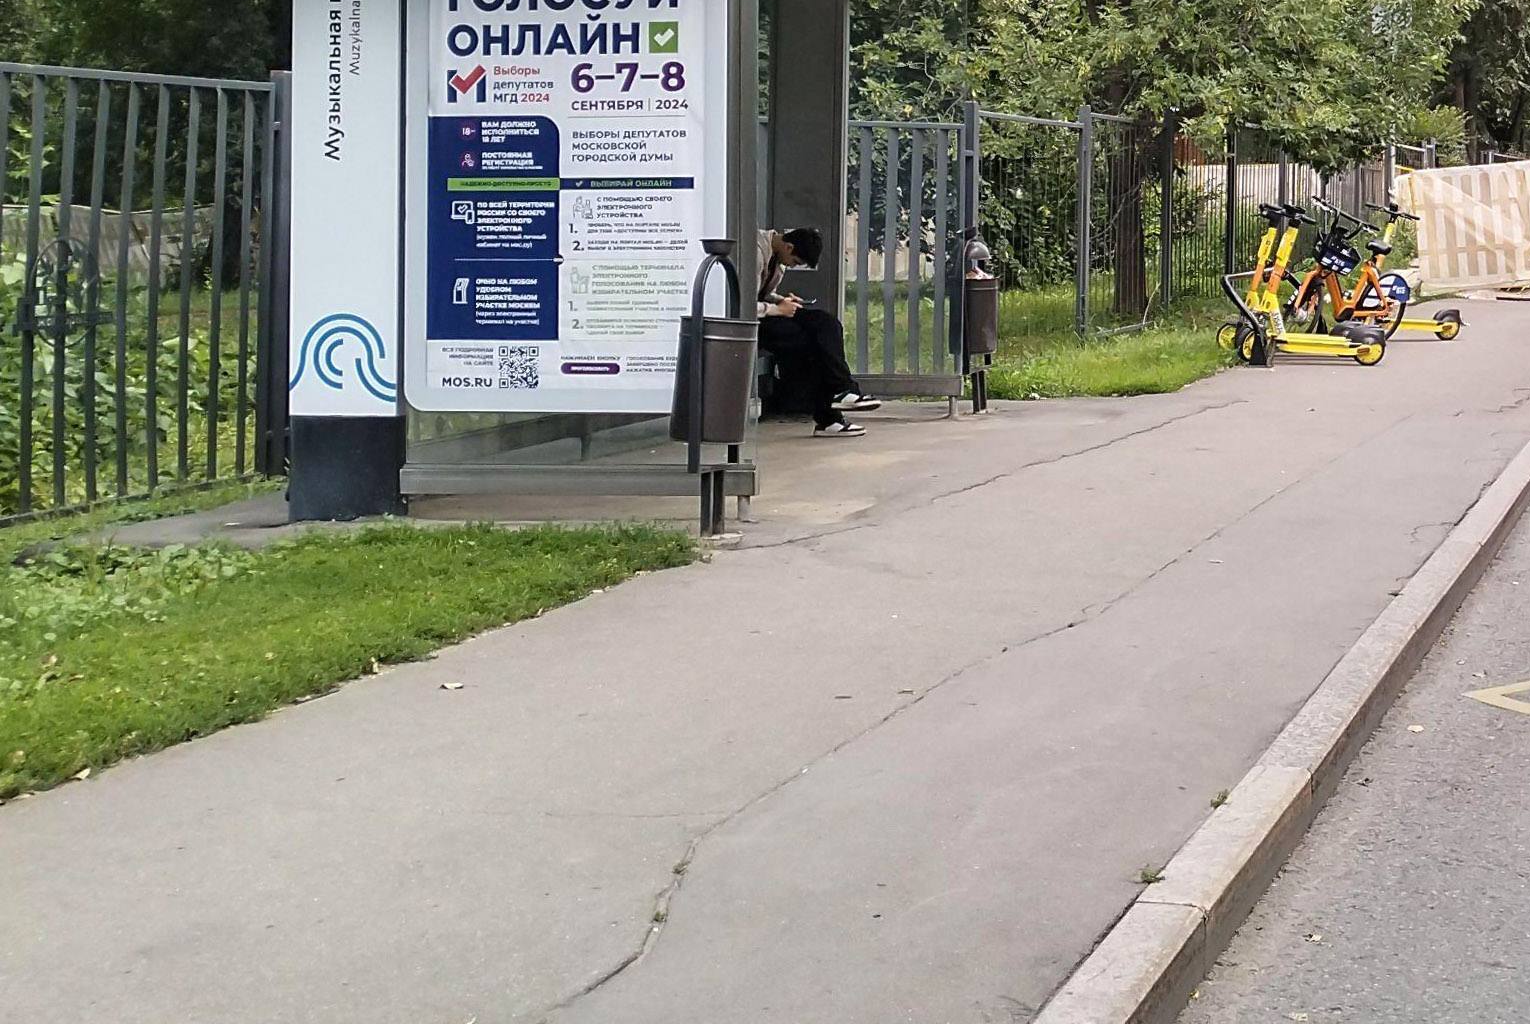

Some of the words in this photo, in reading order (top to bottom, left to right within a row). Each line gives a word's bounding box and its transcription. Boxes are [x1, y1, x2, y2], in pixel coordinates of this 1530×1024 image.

[447, 13, 640, 57] ОНЛАЙН
[493, 65, 540, 75] Выборы
[324, 10, 344, 161] Музыкальная
[493, 79, 554, 90] депутатов
[493, 93, 519, 104] МГД
[520, 93, 550, 103] 2024
[571, 100, 644, 111] СЕНТЯБРЯ
[655, 98, 689, 110] 2024
[572, 129, 620, 139] ВЫБОРЫ
[622, 129, 687, 139] ДЕПУТАТОВ
[571, 140, 647, 151] МОСКОВСКОЙ
[571, 151, 637, 162] ГОРОДСКОЙ
[639, 153, 673, 162] ДУМЫ
[635, 179, 672, 187] ОНЛАЙН
[572, 240, 585, 251] 2.
[571, 318, 584, 330] 2.
[441, 377, 493, 387] MOS.RU
